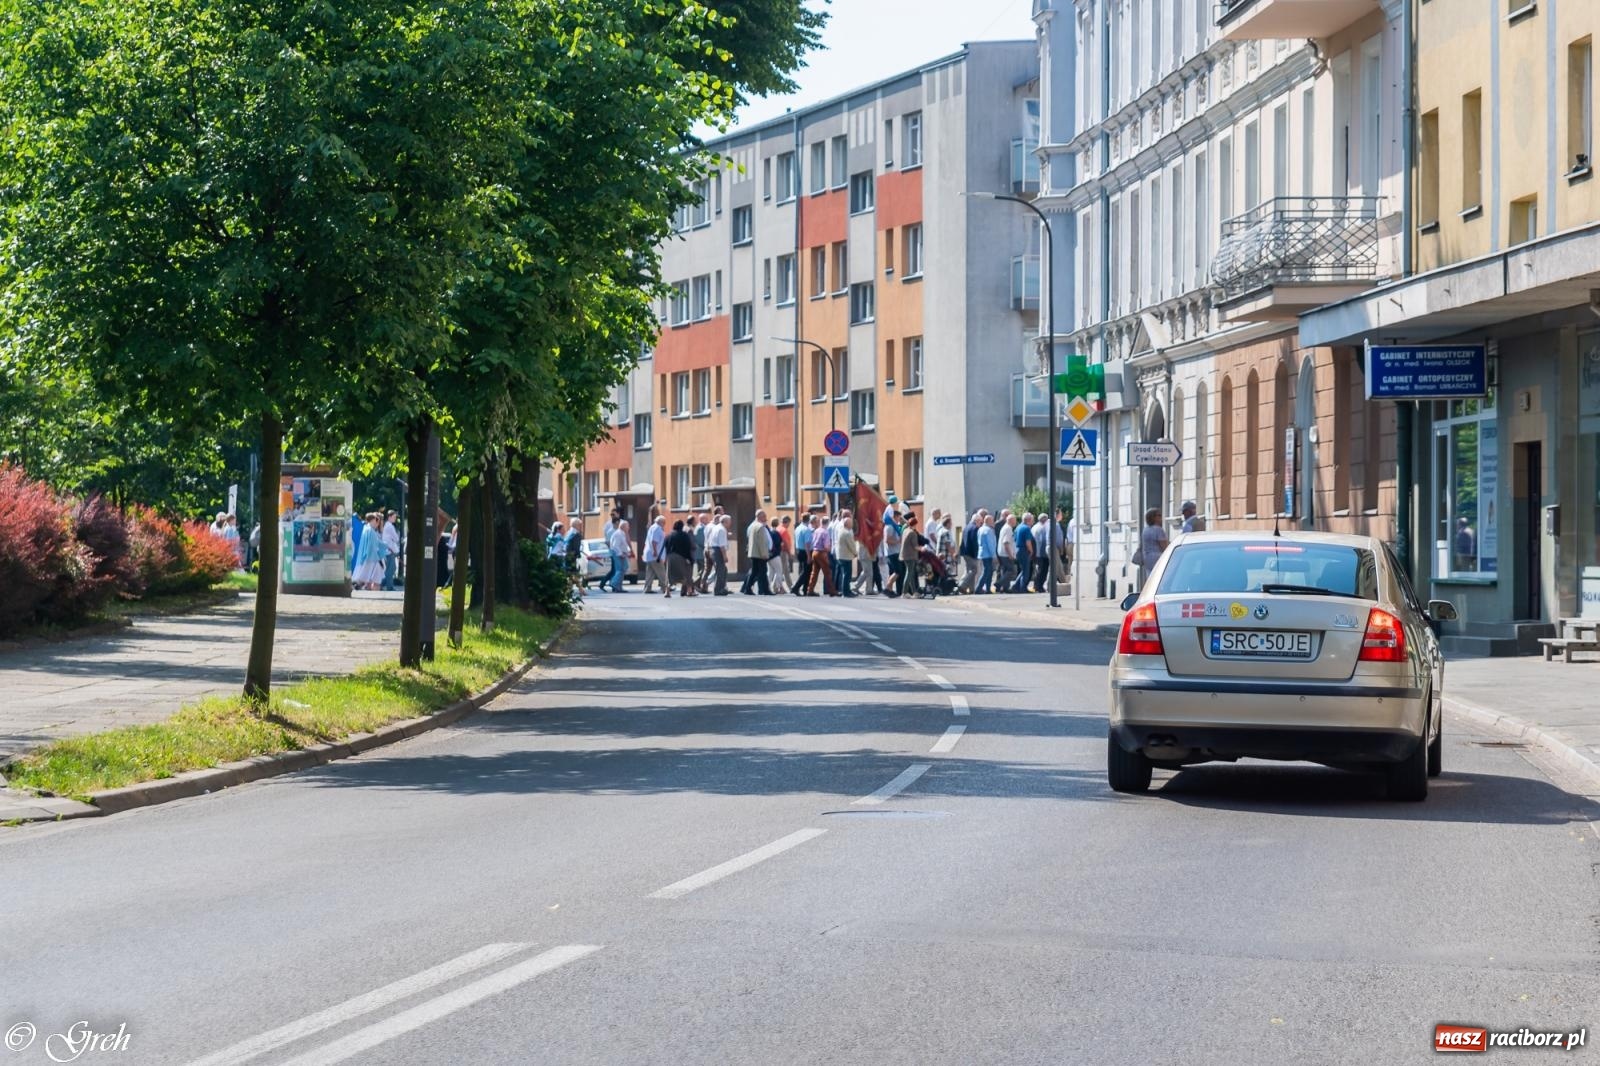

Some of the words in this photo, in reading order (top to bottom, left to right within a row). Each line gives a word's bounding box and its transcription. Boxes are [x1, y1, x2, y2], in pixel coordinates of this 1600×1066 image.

[1380, 352, 1410, 360] GABINET
[1382, 375, 1412, 383] GABINET
[1418, 374, 1474, 382] ORTOPEDYCZNY
[1223, 632, 1260, 650] SRC
[1265, 633, 1308, 651] 50JE
